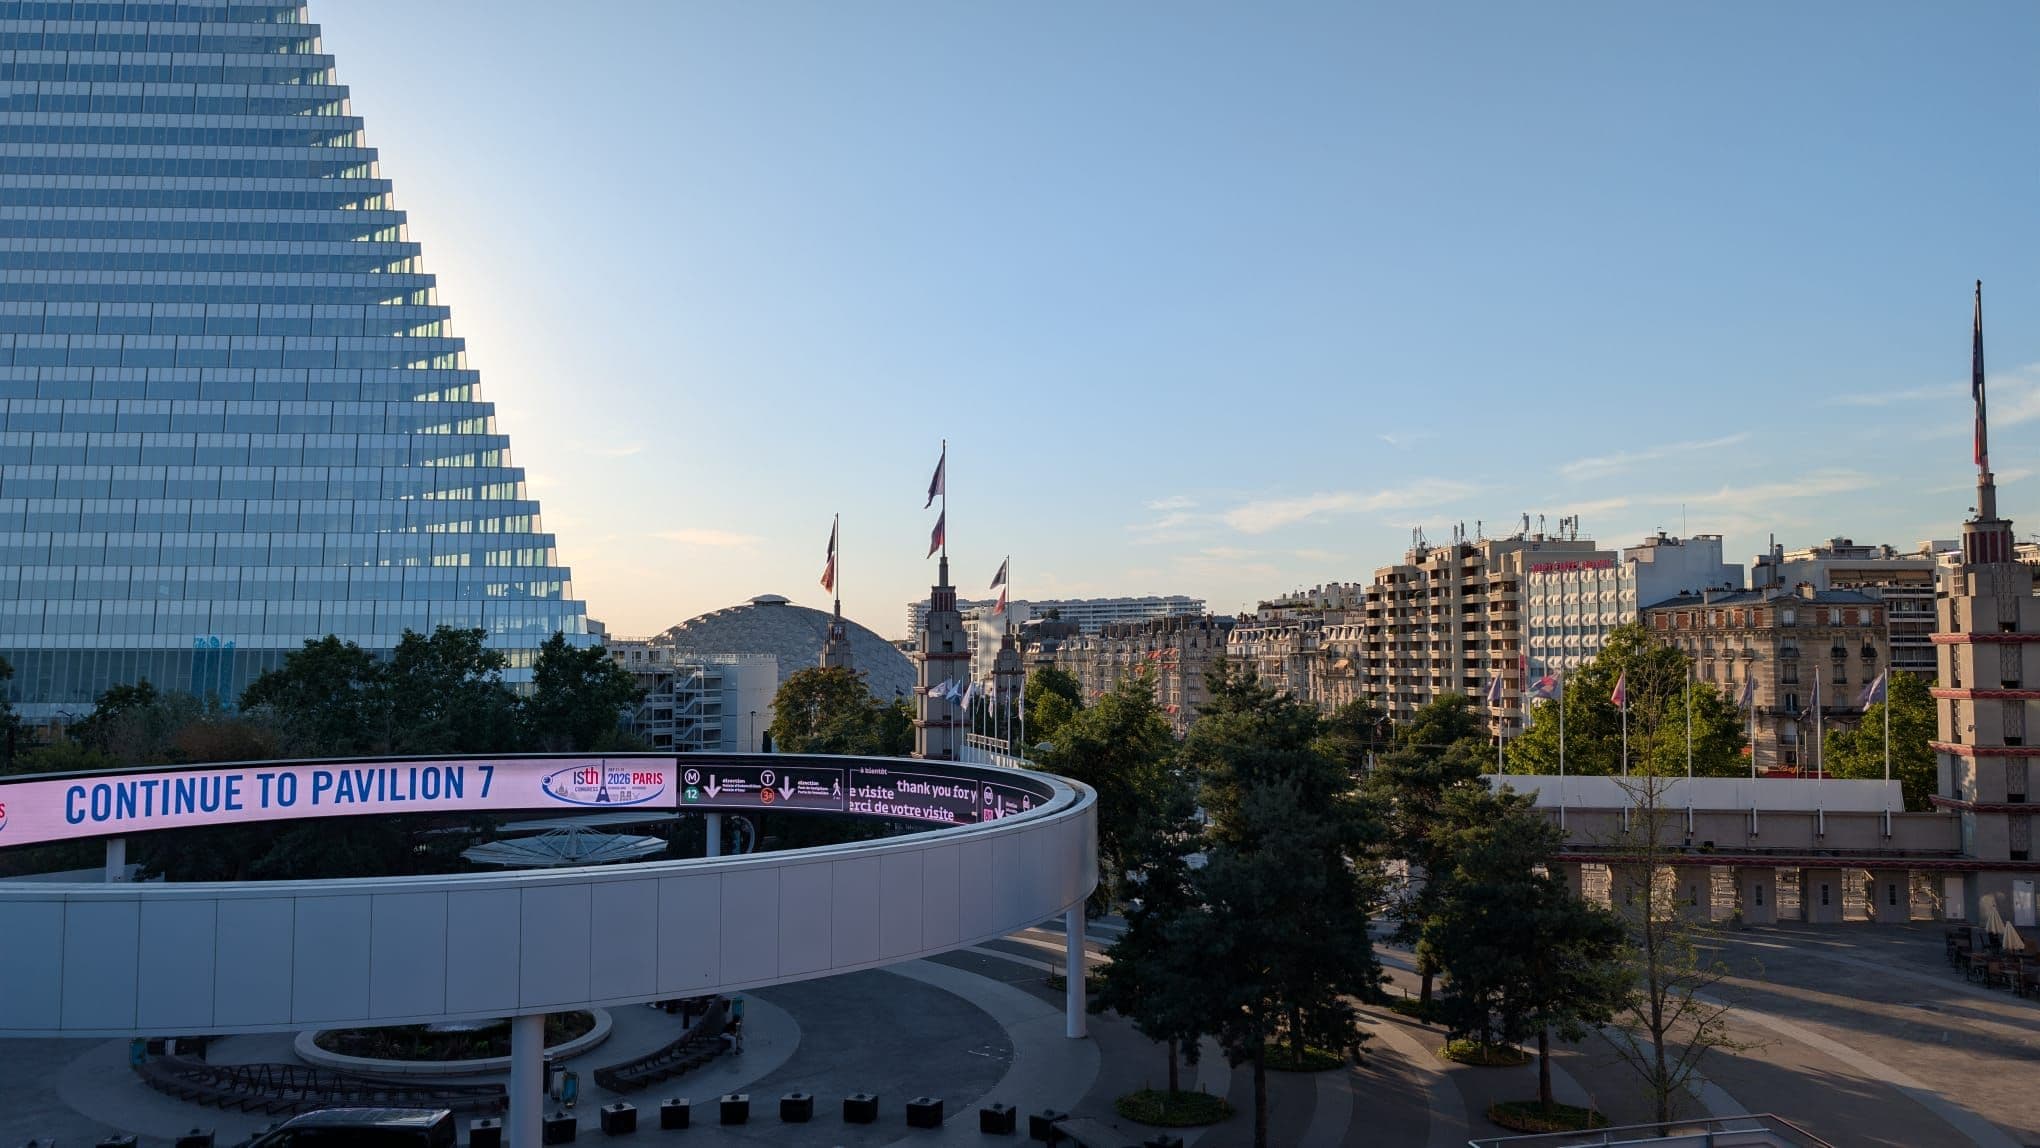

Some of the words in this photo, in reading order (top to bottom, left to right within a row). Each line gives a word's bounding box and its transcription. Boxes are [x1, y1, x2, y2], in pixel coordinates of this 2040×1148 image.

[607, 773, 631, 785] 2026
[632, 772, 663, 785] PARIS
[687, 772, 698, 781] M
[764, 774, 772, 784] T
[65, 774, 244, 825] CONTINUE
[256, 772, 298, 809] TO
[312, 765, 465, 806] PAVILION
[478, 765, 495, 799] 7
[685, 789, 698, 799] 12
[858, 784, 895, 800] visite
[896, 779, 931, 795] thank
[932, 784, 951, 799] you
[952, 785, 970, 800] for
[874, 801, 889, 813] de
[890, 803, 921, 817] votre
[922, 805, 955, 821] visite
